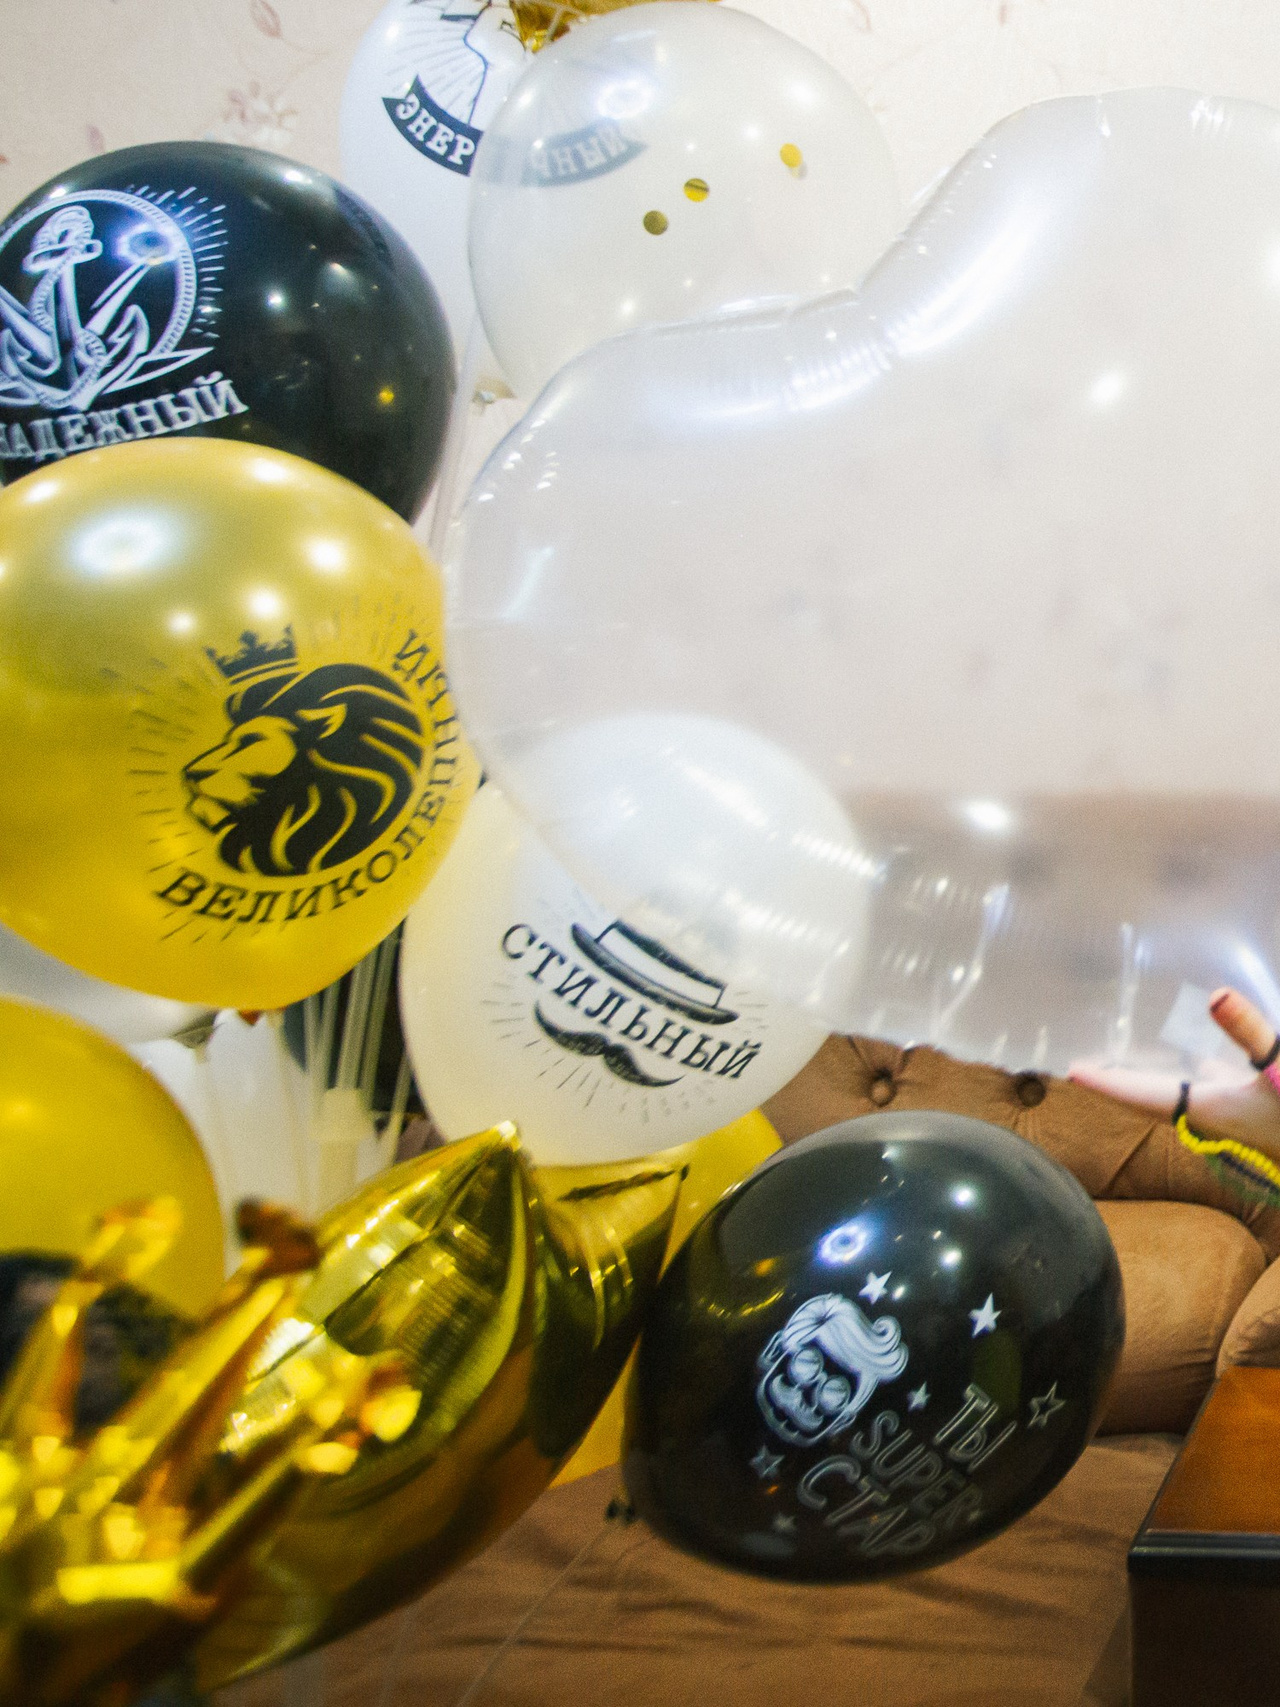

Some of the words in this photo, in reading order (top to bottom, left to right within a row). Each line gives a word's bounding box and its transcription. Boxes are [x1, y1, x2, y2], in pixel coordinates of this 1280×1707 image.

[0, 371, 249, 462] АДЕЖНЫЙ
[500, 923, 762, 1079] СТИЛЬНЫЙ
[852, 1409, 983, 1531] SUPER
[932, 1382, 1018, 1474] ТЫ
